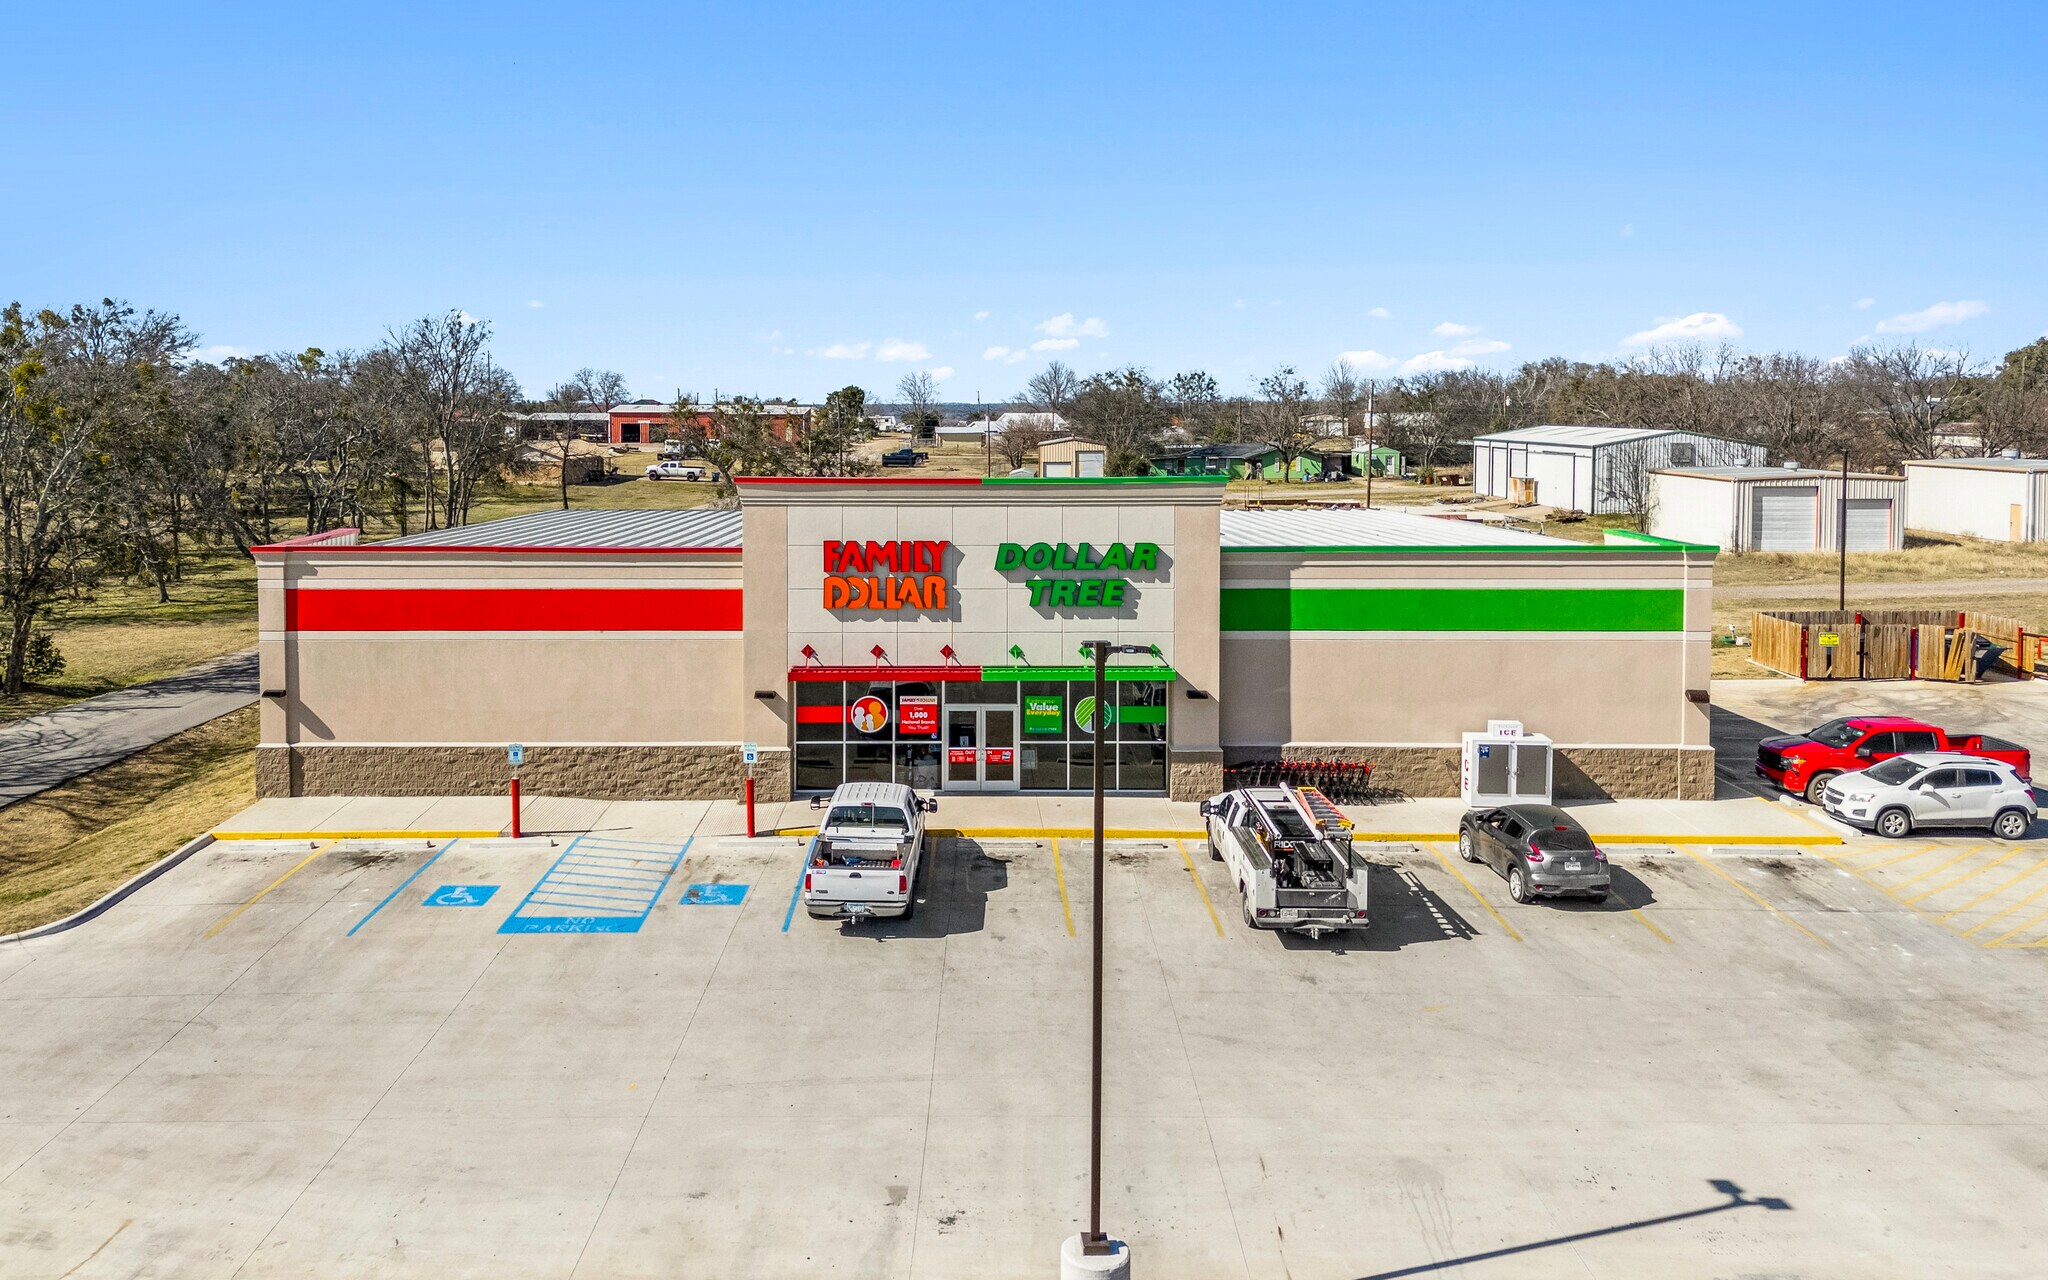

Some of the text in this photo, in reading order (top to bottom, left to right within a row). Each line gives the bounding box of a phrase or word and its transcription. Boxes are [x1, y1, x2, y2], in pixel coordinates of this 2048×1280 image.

[823, 540, 950, 573] FAMILY
[994, 542, 1160, 571] DOLLAR
[823, 575, 948, 610] DOLLAR
[1025, 579, 1128, 608] TREE
[909, 711, 929, 719] 1,000
[1026, 708, 1061, 717] Everyday
[1029, 702, 1059, 711] Value
[564, 917, 595, 925] NO
